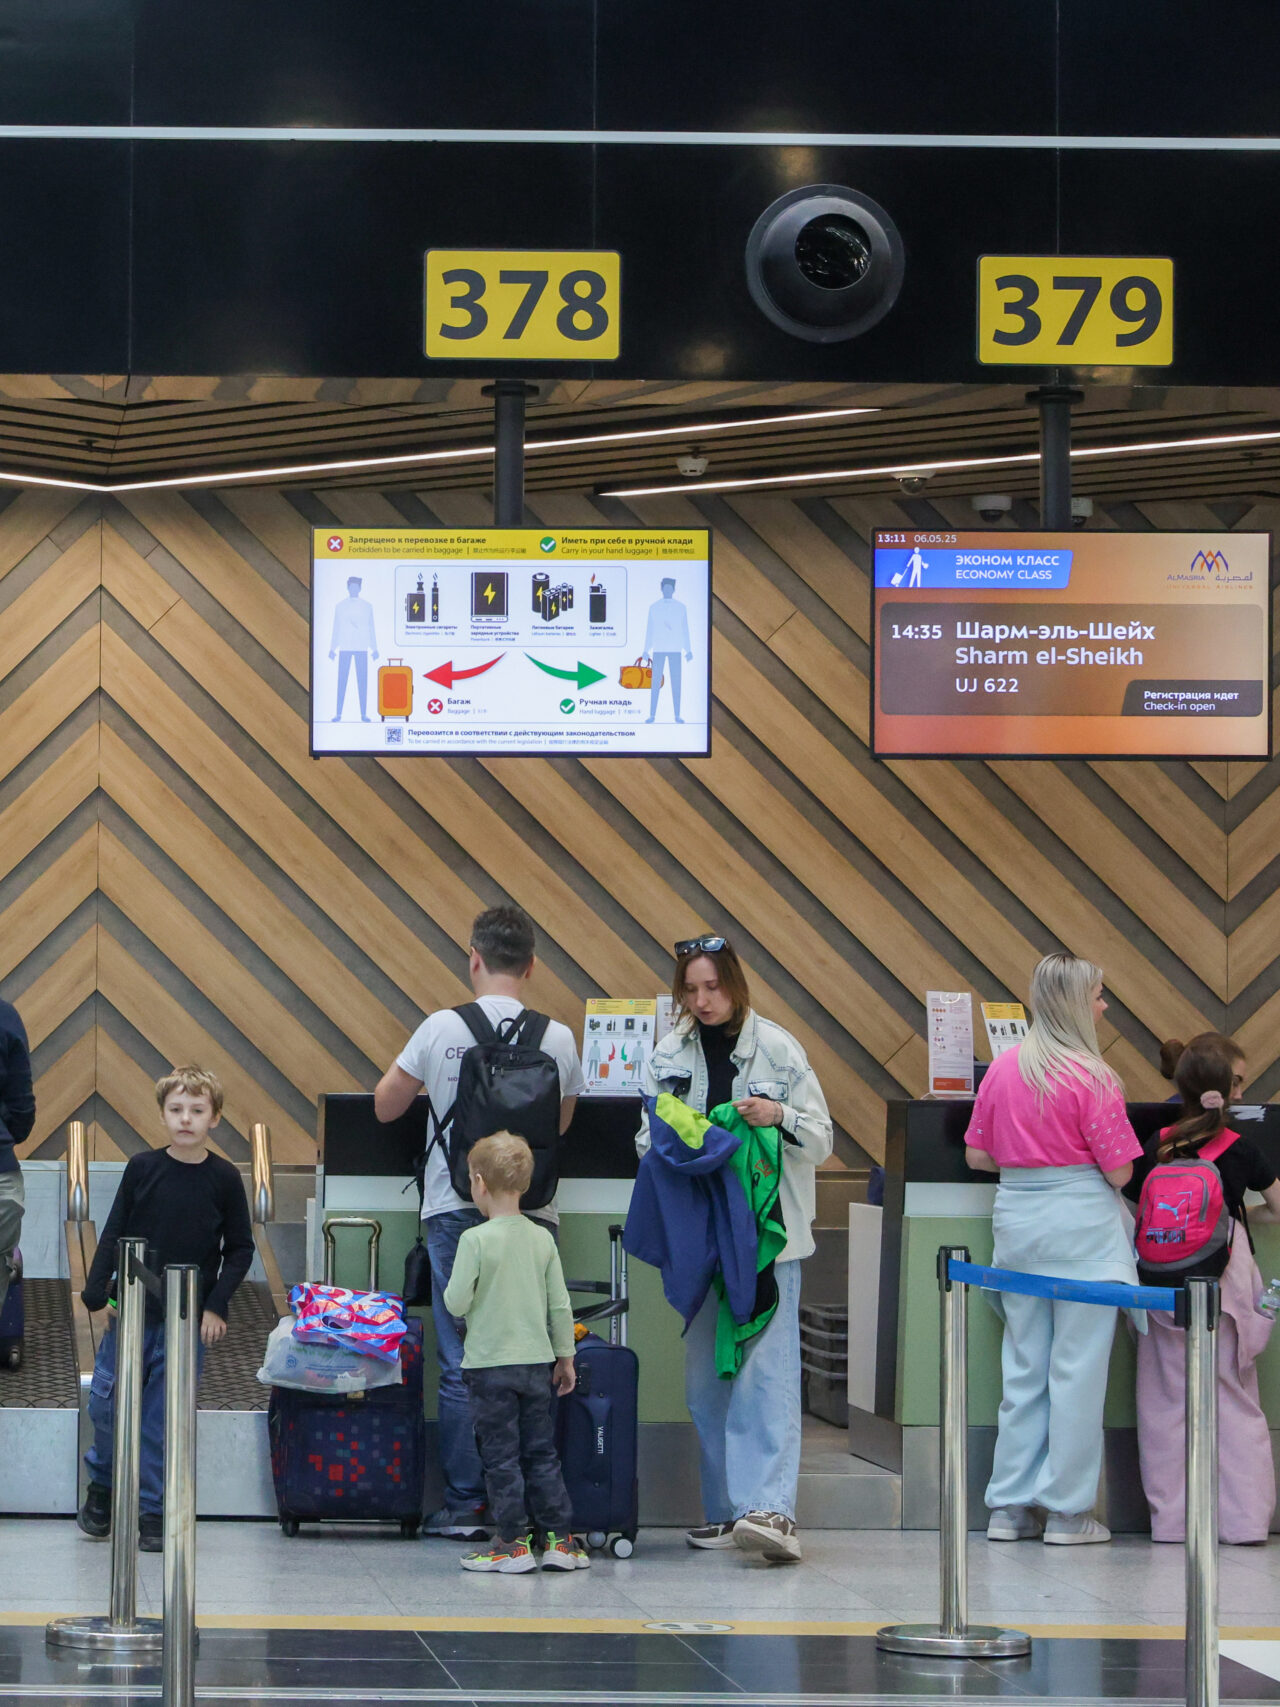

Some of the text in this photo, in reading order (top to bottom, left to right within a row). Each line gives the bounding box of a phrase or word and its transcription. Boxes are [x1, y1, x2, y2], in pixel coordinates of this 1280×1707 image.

[438, 268, 610, 342] 378
[992, 274, 1163, 348] 379
[878, 534, 957, 543] 13:11 06.05.25
[956, 555, 1060, 566] ЭКОНОМ КЛАСС
[956, 570, 1052, 579] ECONOMY CLASS
[892, 624, 942, 640] 14:35
[956, 621, 1156, 642] Шарм-эль-Шейх
[956, 647, 1144, 665] Sharm el-Sheikh
[956, 678, 1019, 693] UJ 622
[1144, 691, 1239, 701] Регистрация идет
[1144, 702, 1216, 712] Check-in open
